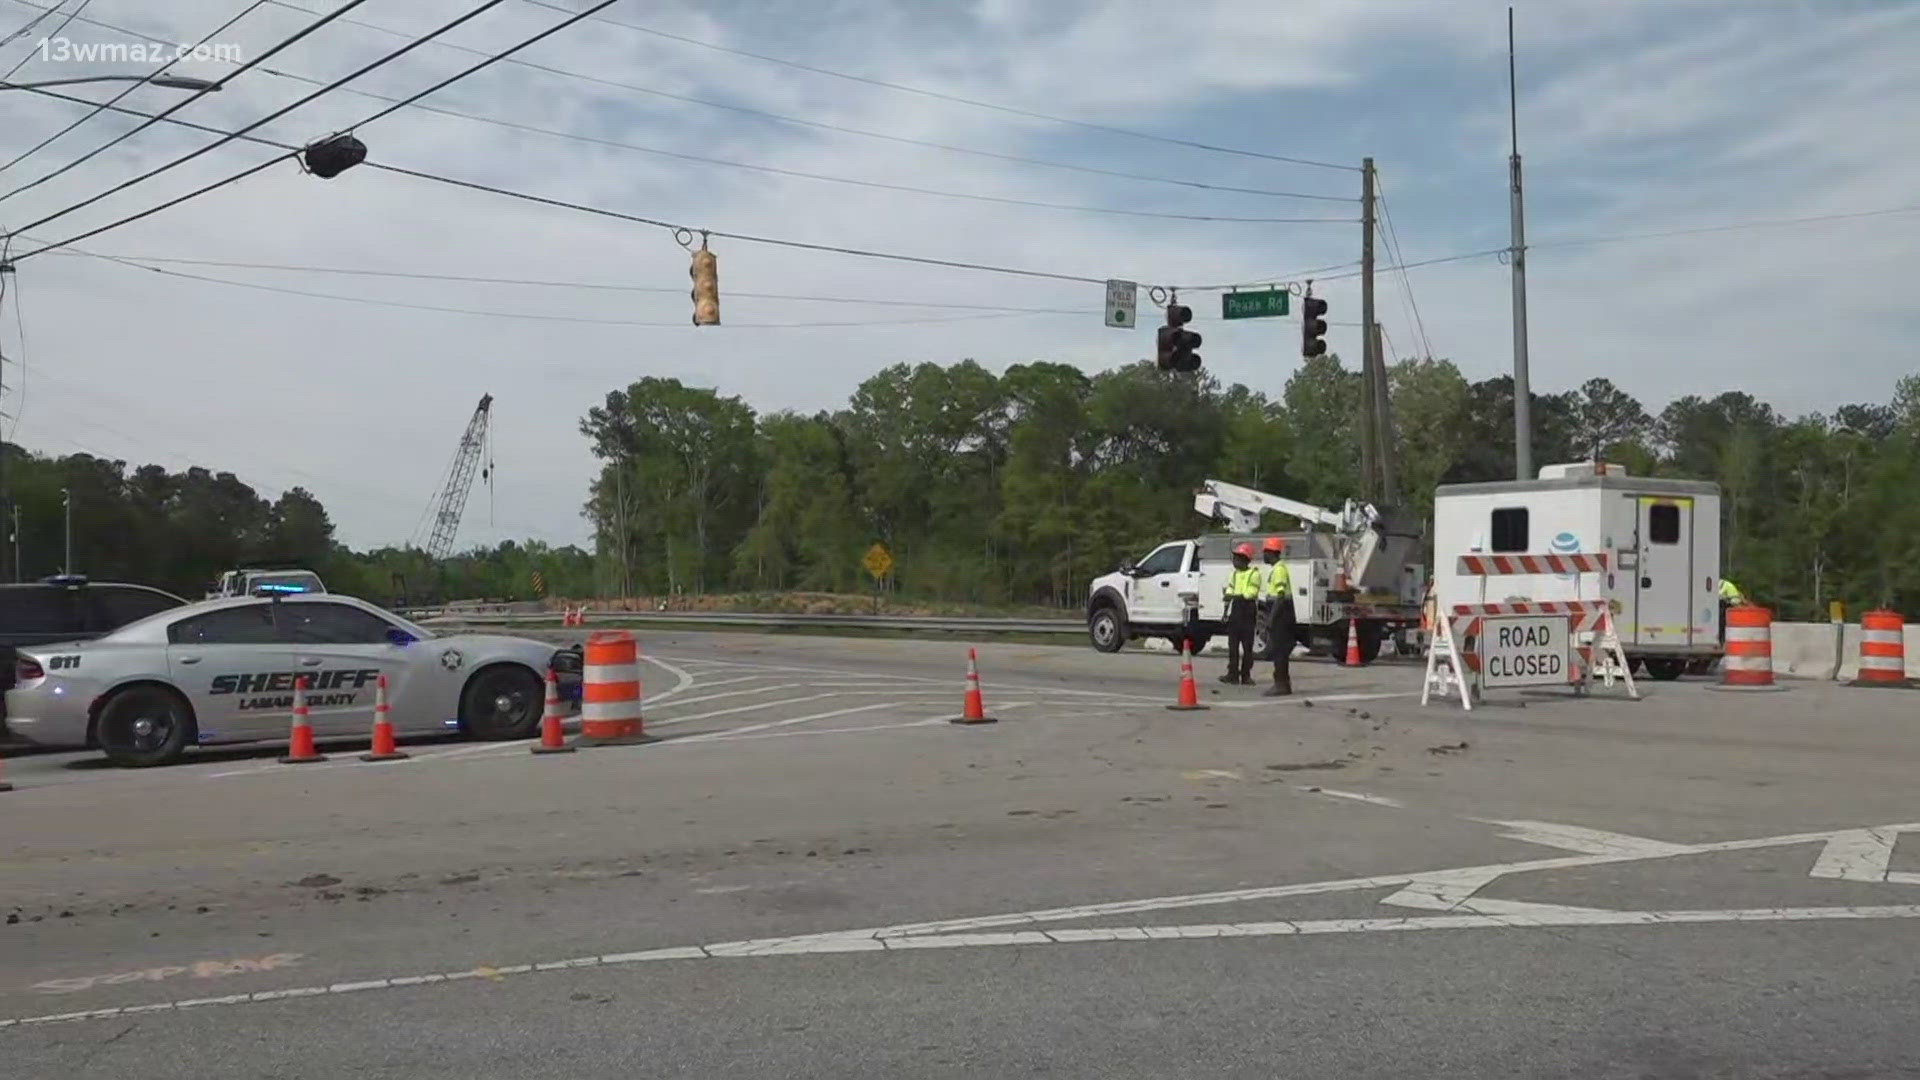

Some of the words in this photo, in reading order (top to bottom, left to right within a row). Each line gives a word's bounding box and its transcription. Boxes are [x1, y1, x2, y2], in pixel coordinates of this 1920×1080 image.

[1268, 296, 1283, 310] Rd
[1499, 625, 1550, 648] ROAD
[1489, 654, 1561, 677] CLOSED
[209, 669, 380, 694] SHERIFF
